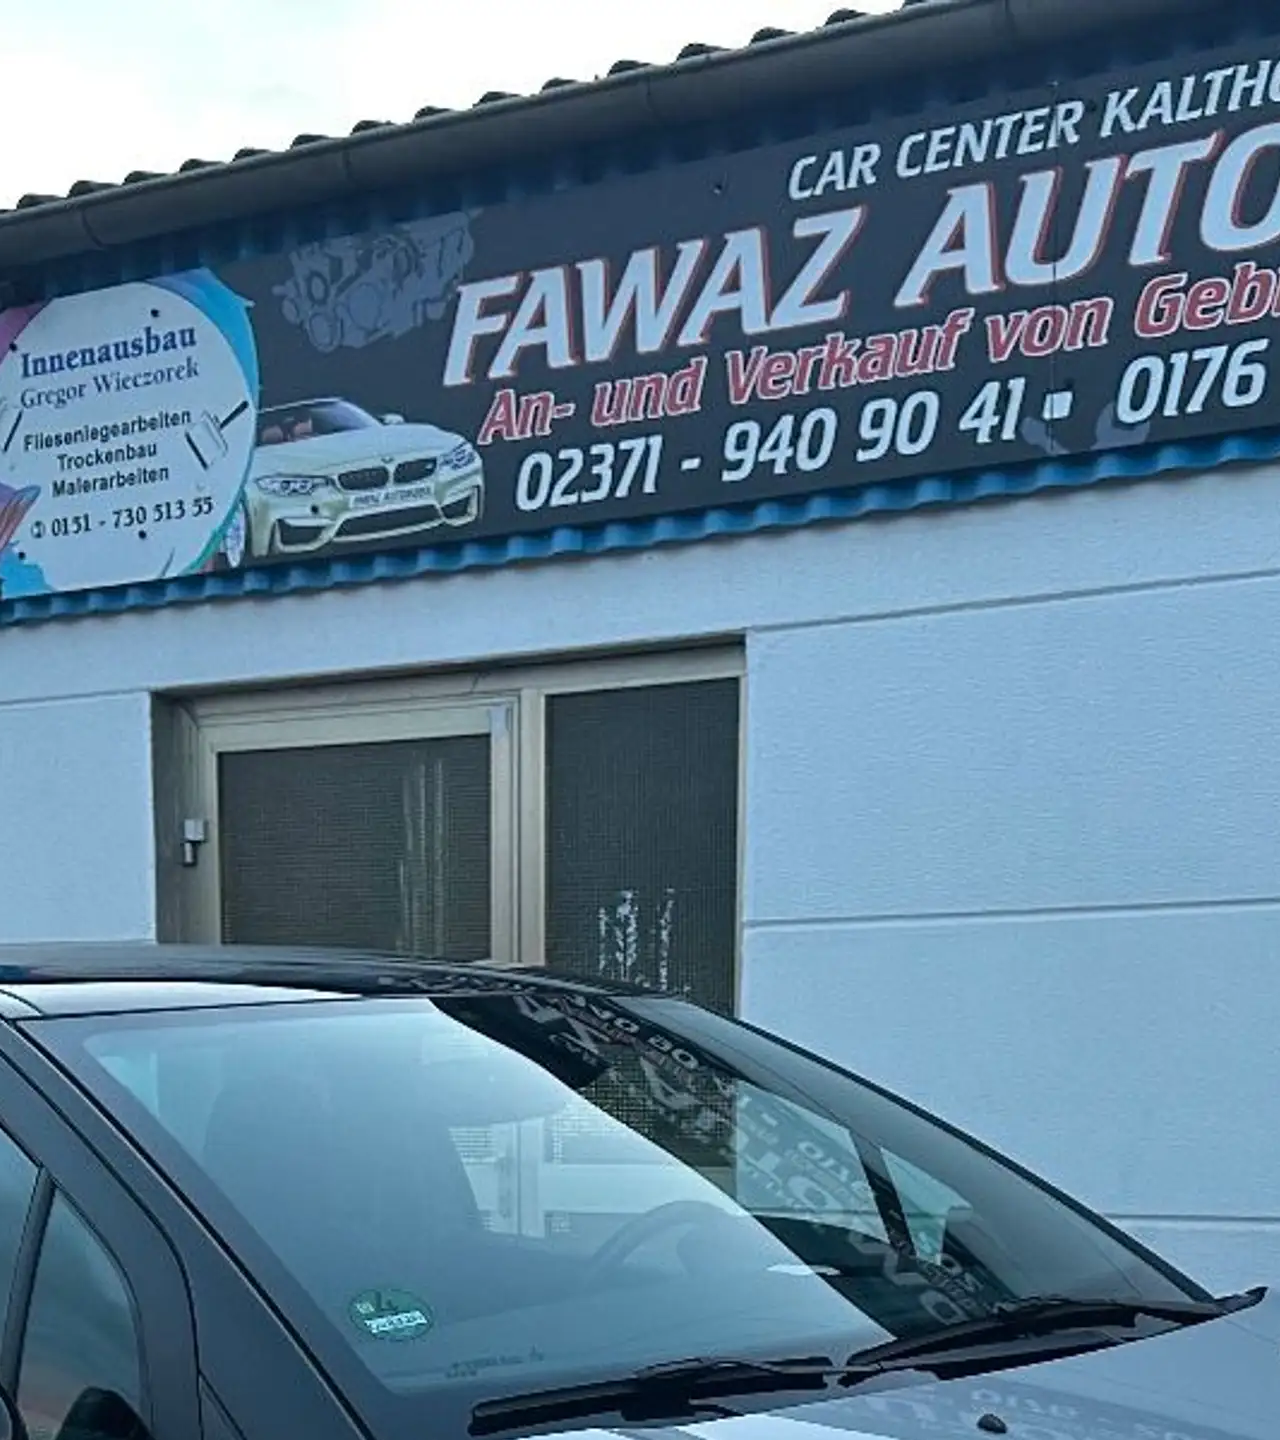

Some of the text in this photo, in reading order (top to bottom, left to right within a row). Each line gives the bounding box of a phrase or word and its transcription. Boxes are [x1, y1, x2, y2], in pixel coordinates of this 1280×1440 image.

[789, 144, 881, 200] CAR
[896, 101, 1085, 178] CENTER
[442, 206, 869, 388] FAWAZ
[21, 326, 197, 379] Innenausbau
[477, 388, 574, 446] An-
[590, 356, 707, 431] und
[725, 309, 975, 404] Verkauf
[986, 297, 1114, 364] von
[21, 382, 87, 409] Gregor
[23, 411, 191, 450] Fliesenlegearbeiten
[516, 437, 662, 512] 02371
[721, 407, 837, 483] 940
[856, 392, 939, 464] 90
[958, 377, 1026, 448] 41
[1115, 338, 1267, 424] 0176
[57, 443, 157, 472] Trockenbau
[52, 467, 169, 498] Malerarbeiten
[51, 513, 91, 537] 0151
[112, 506, 147, 530] 730
[153, 499, 186, 522] 513
[191, 496, 214, 516] 55
